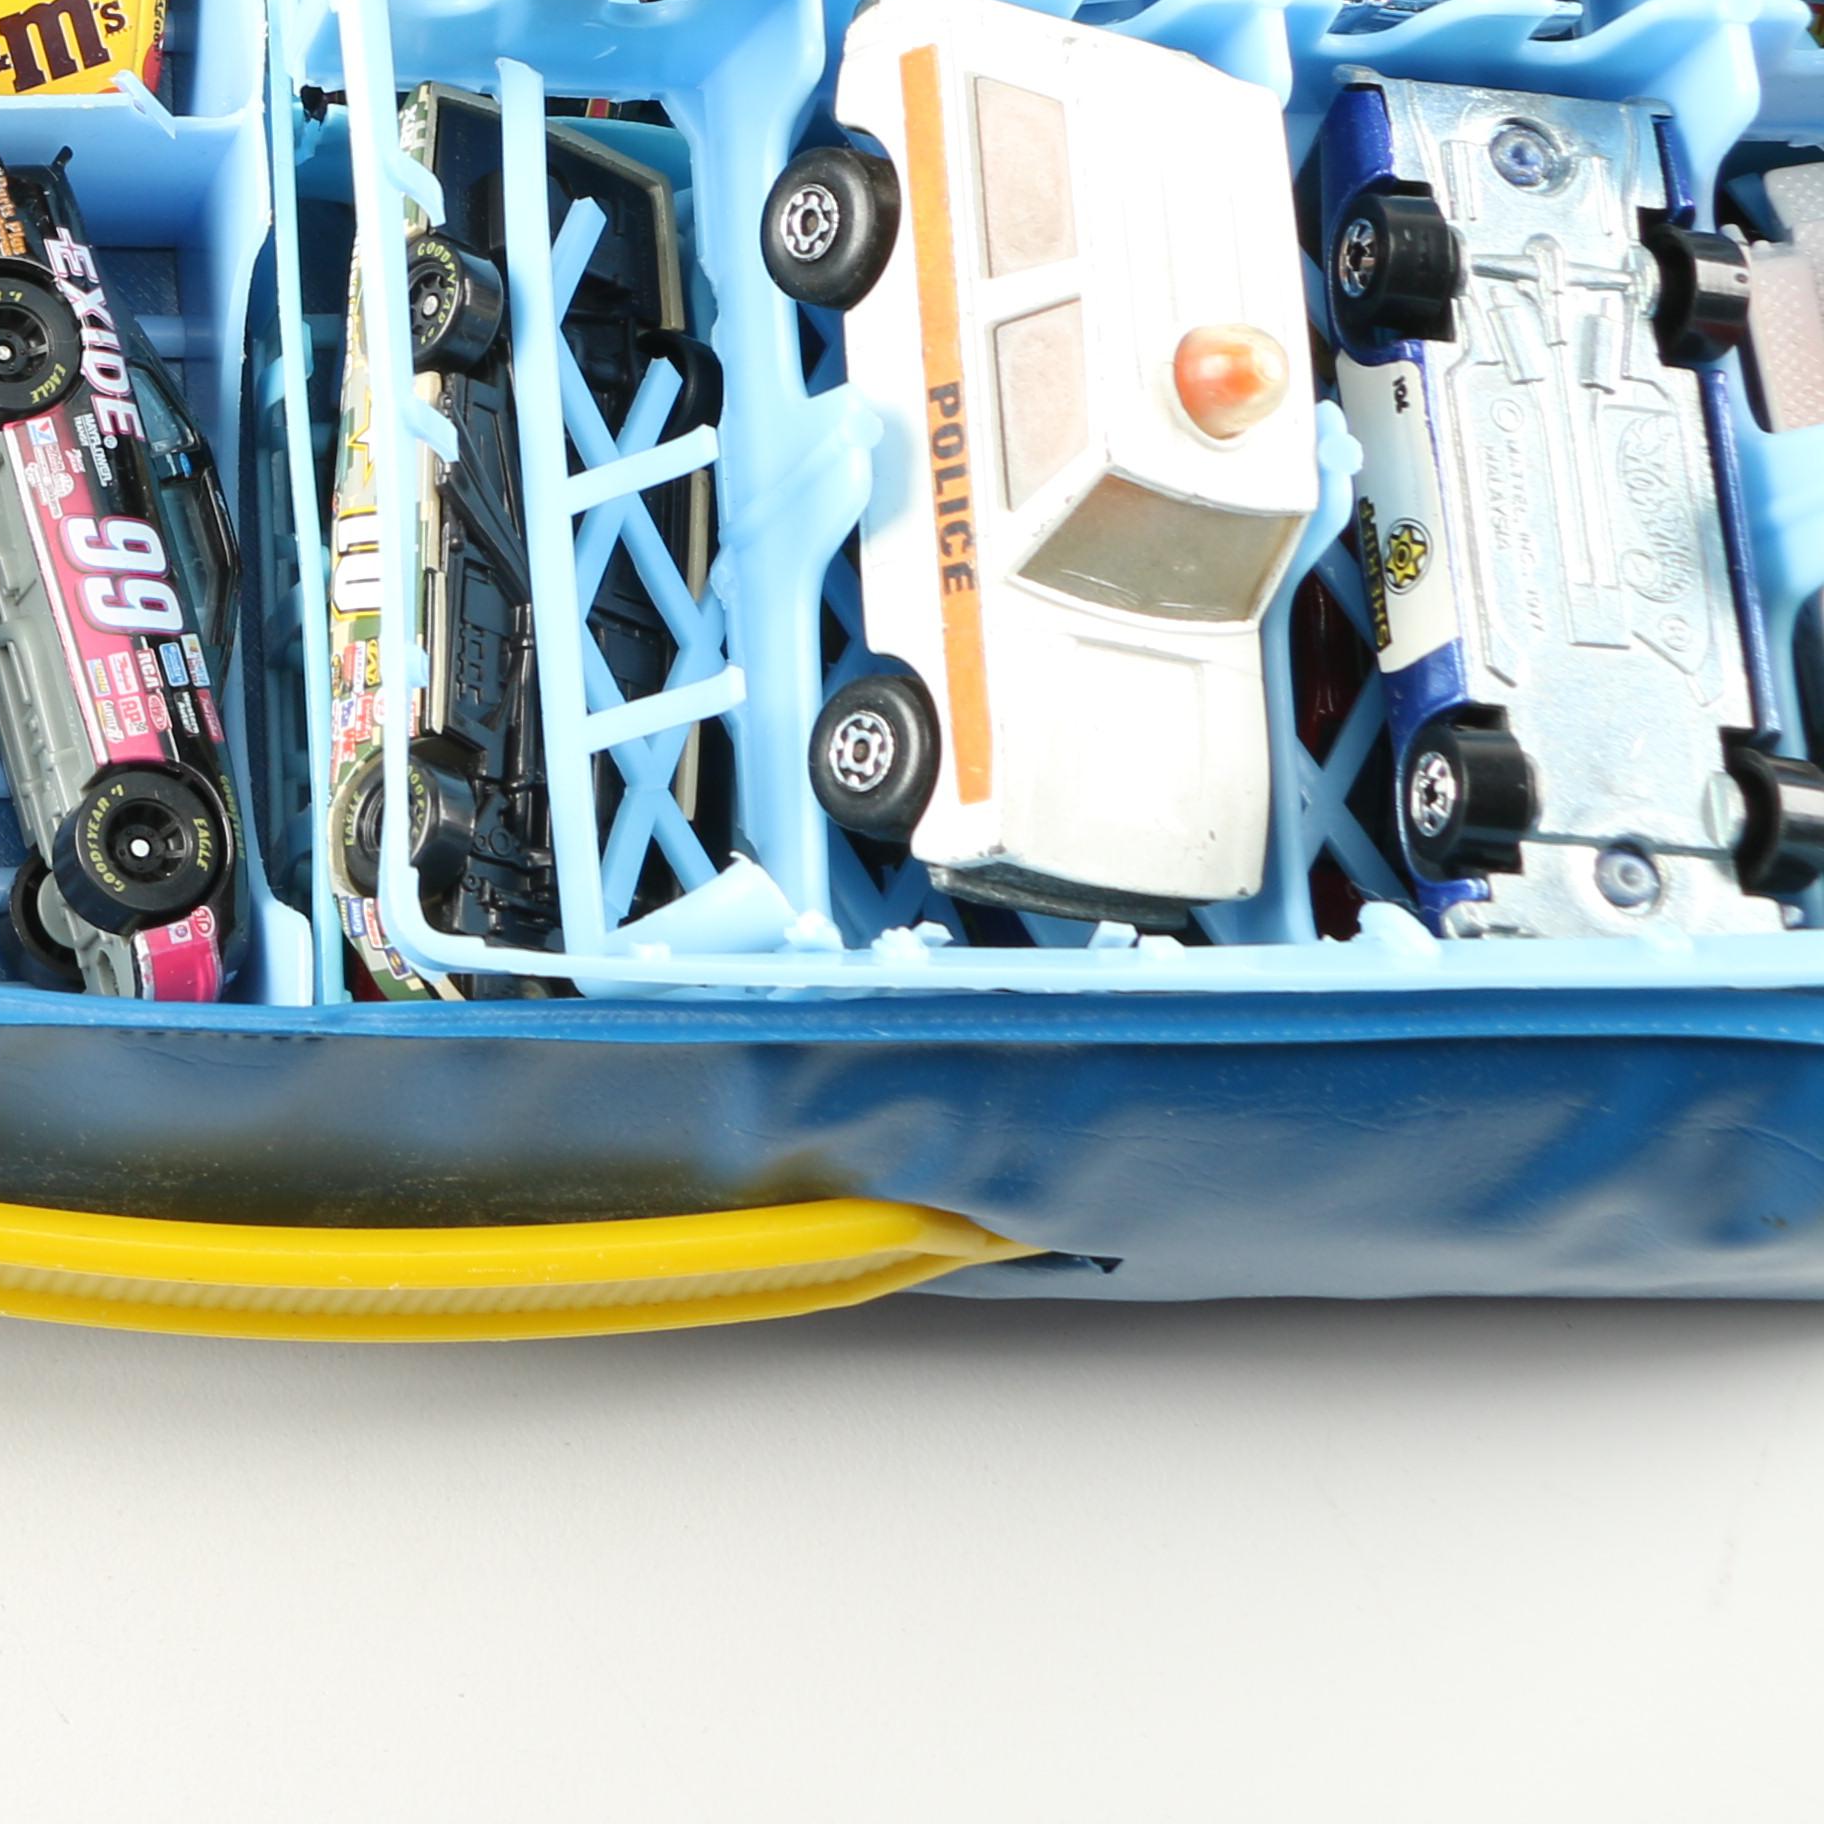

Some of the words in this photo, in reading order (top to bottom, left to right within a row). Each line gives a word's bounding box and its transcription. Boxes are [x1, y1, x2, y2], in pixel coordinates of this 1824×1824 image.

[416, 241, 460, 328] GOODYEAR
[44, 226, 148, 443] EXIDE
[30, 362, 68, 405] EAGLE
[85, 413, 113, 483] MAYFLOWER
[926, 380, 978, 596] POLICE
[58, 514, 185, 633] 99
[87, 795, 127, 895] GOODYEAR
[191, 816, 209, 873] EAGLE
